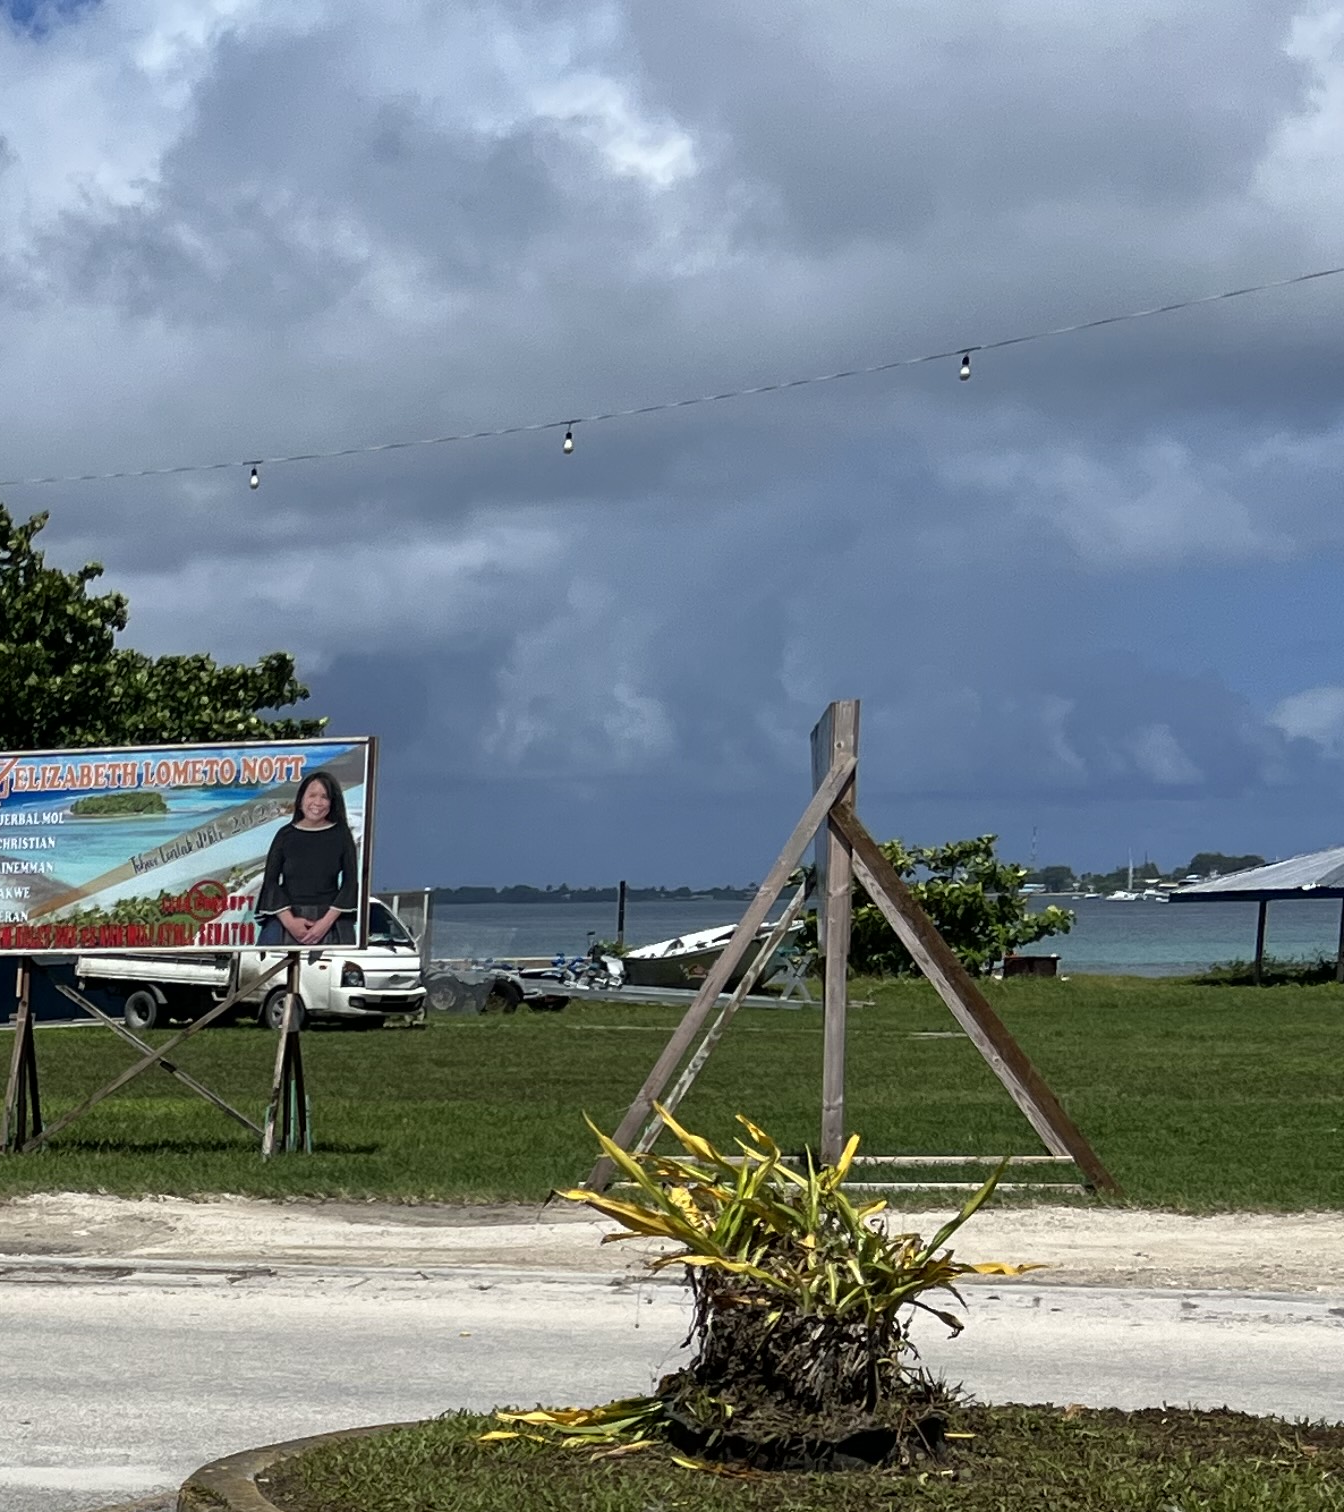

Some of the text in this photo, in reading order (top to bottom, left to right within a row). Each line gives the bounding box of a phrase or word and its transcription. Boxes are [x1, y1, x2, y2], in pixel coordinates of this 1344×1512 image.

[13, 755, 305, 793] ELIZABETH LOMETO NOTT
[199, 922, 255, 945] SENATOR
